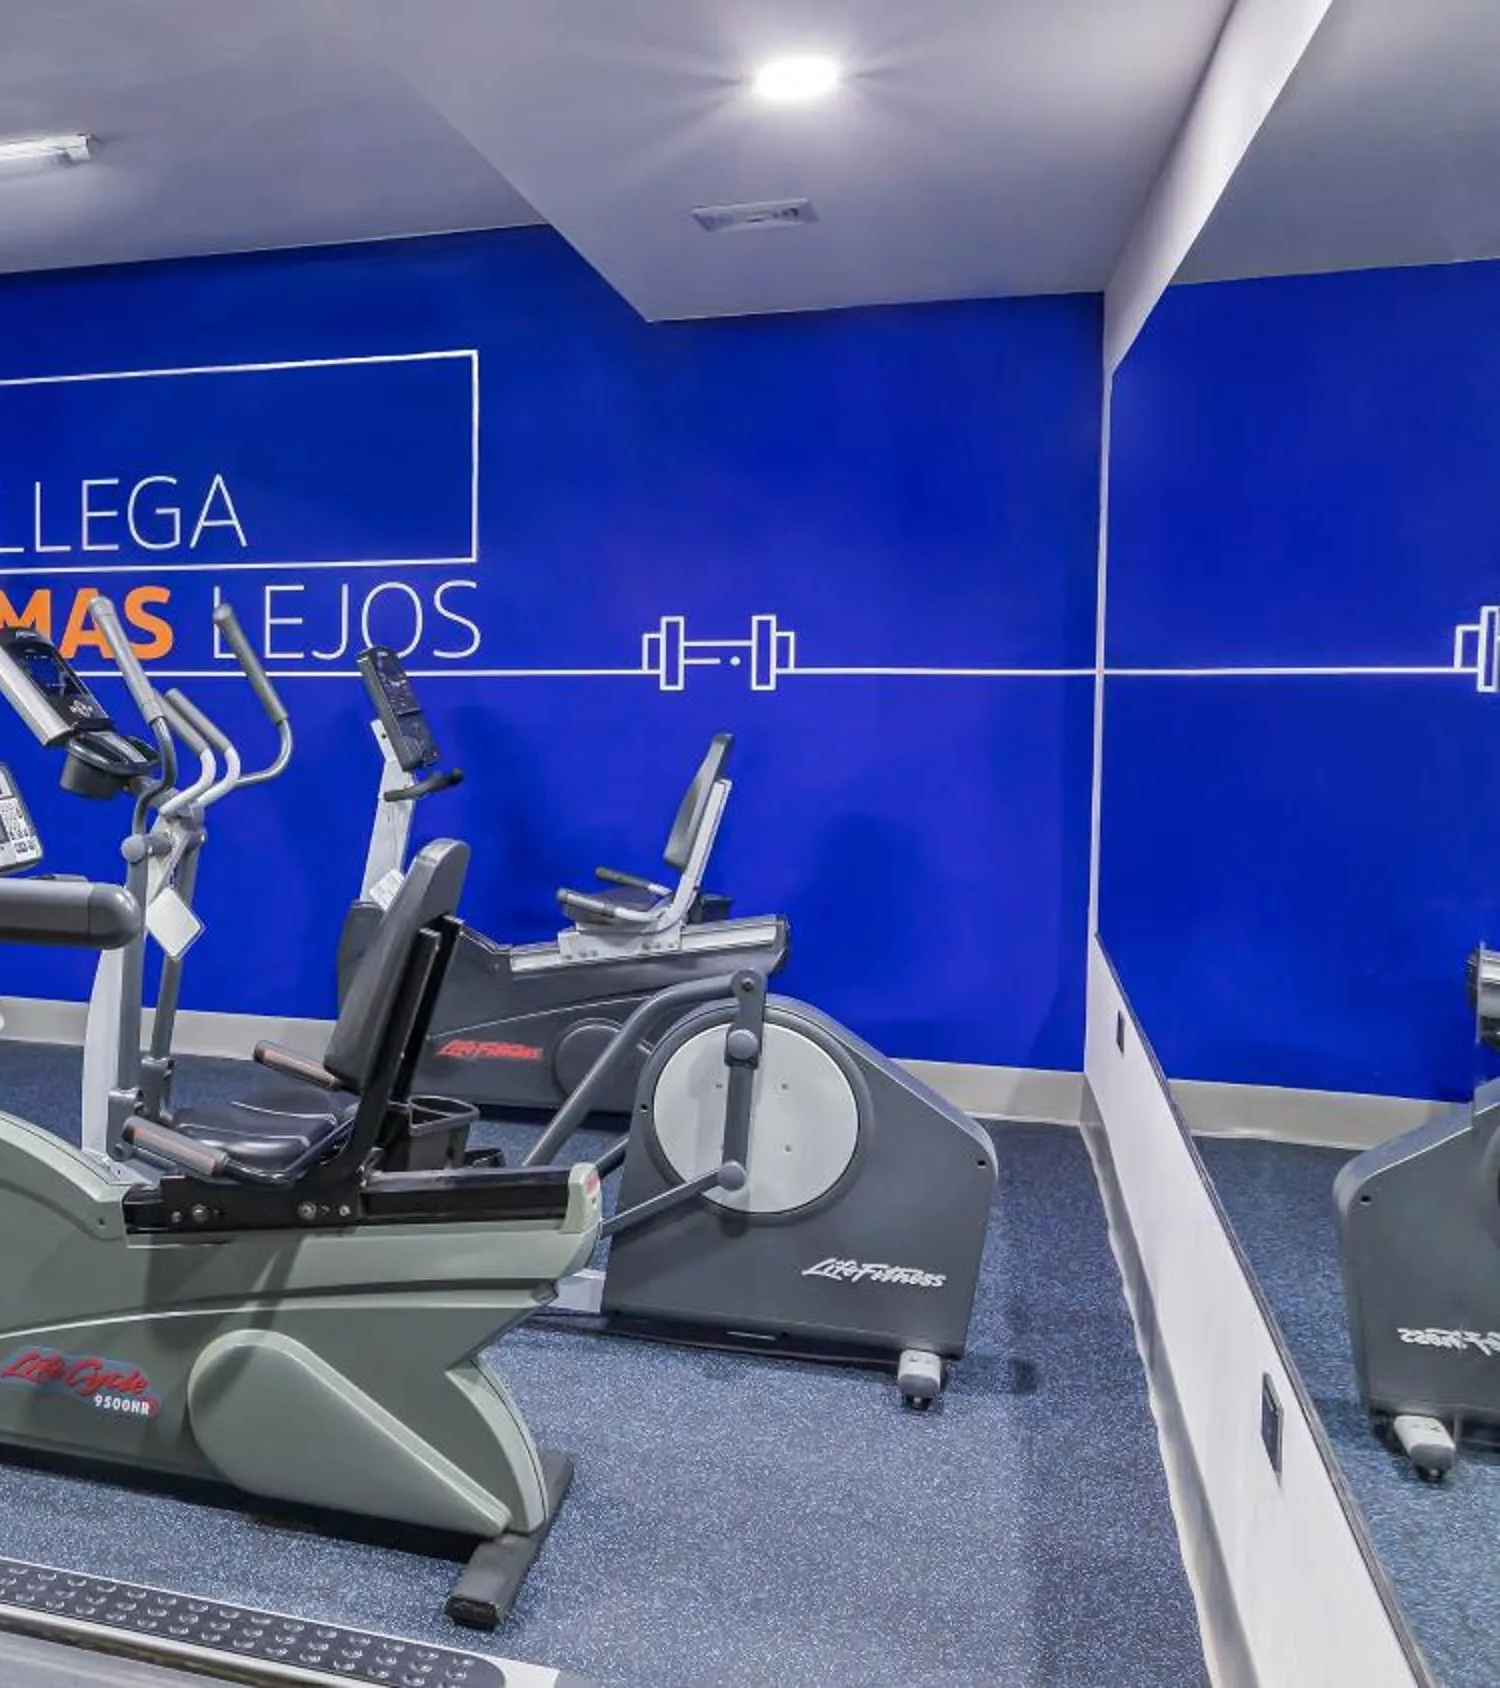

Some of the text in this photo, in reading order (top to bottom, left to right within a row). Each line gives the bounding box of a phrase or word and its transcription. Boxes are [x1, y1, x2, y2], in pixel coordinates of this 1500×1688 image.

[212, 580, 483, 660] LEJOS
[802, 1257, 947, 1287] Life Fitness
[0, 1351, 149, 1397] Life Cycle
[95, 1394, 149, 1415] 9500HR
